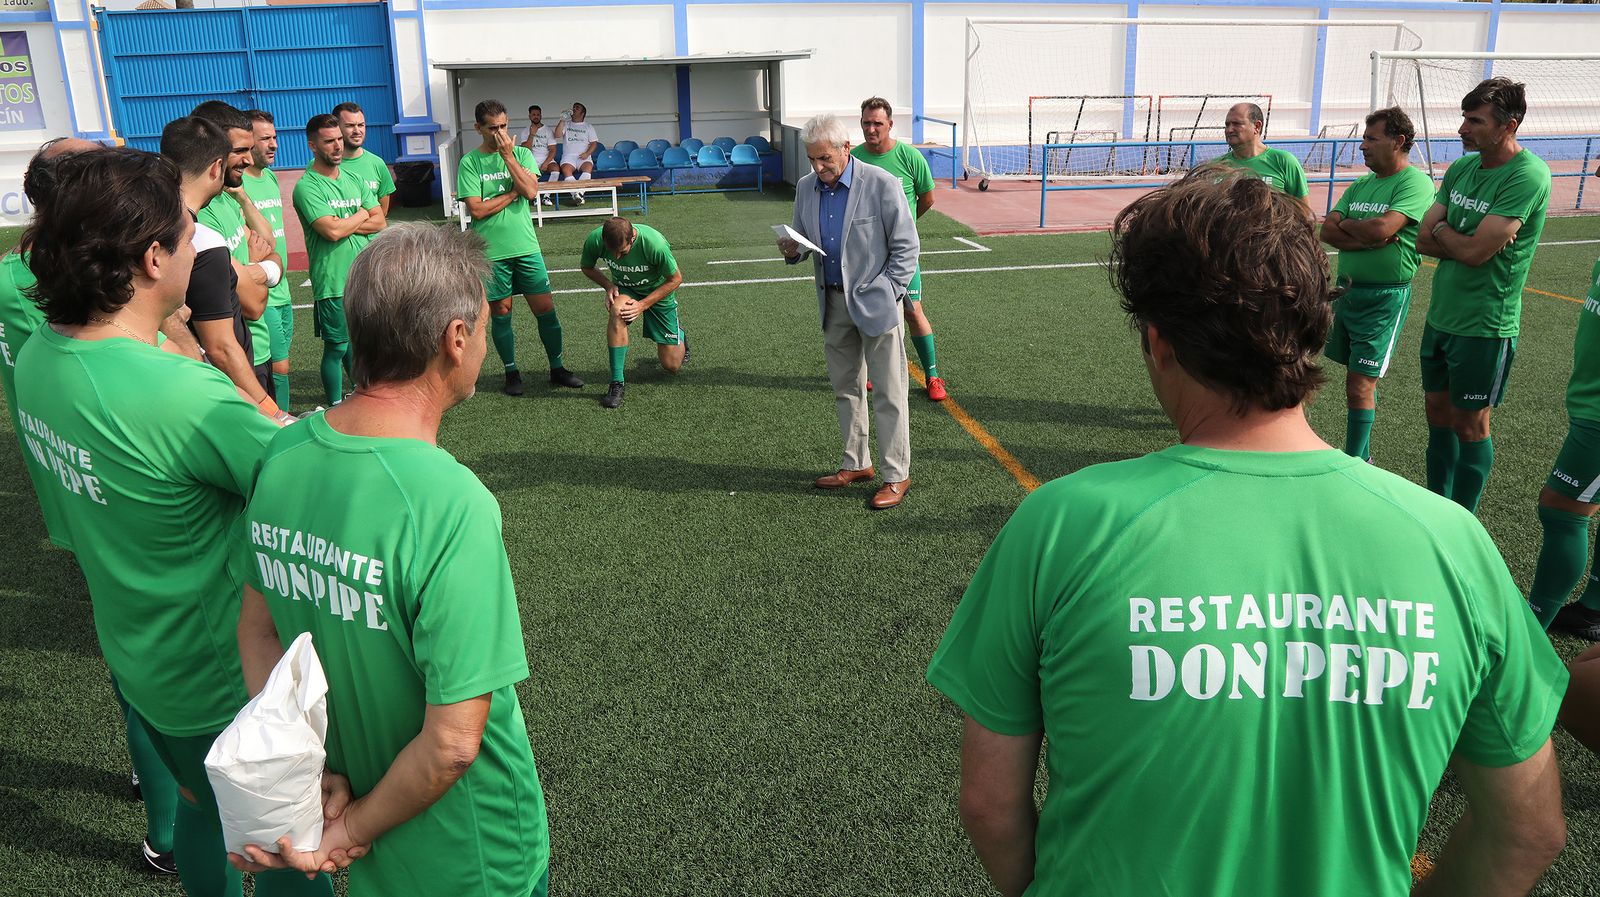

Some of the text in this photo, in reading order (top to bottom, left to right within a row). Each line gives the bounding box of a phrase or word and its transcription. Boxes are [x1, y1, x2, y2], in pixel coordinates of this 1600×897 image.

[498, 184, 505, 192] A
[46, 446, 108, 506] PEPE
[1553, 468, 1579, 487] Joma
[251, 520, 384, 586] RESTAURANTE
[256, 551, 313, 600] DON
[1129, 593, 1435, 639] RESTAURANTE
[1128, 641, 1440, 710] DON PEPE
